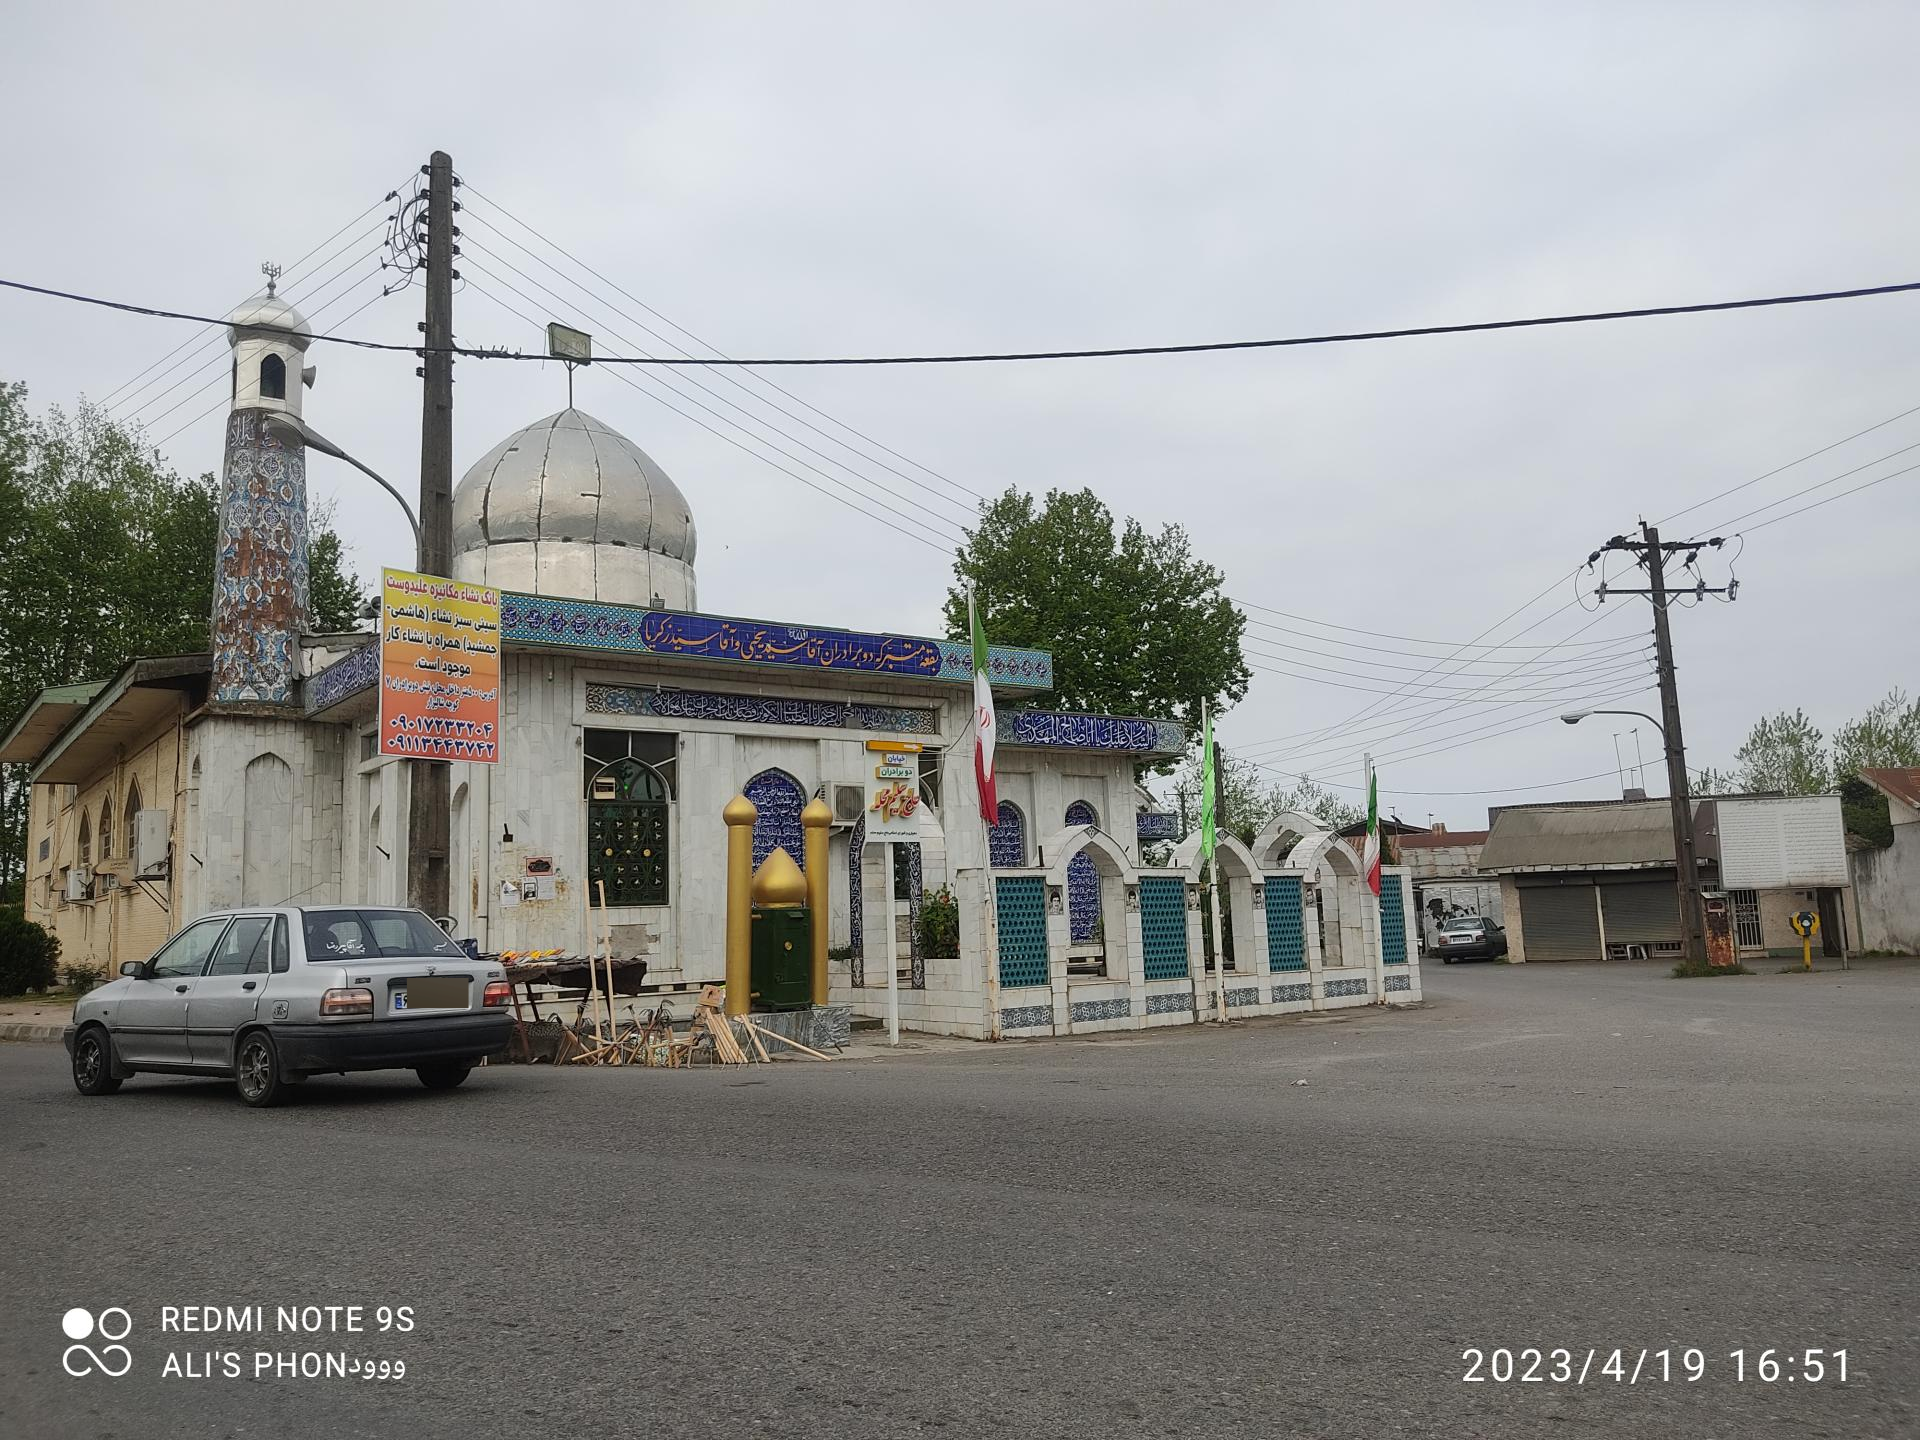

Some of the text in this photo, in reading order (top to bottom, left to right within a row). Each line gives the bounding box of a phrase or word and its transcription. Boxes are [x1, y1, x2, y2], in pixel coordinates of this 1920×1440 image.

[386, 575, 498, 606] بانک نشاء مکانیزه علیدوست
[431, 610, 452, 625] نشاء
[453, 614, 472, 628] سبز
[474, 618, 498, 632] سینی
[386, 625, 498, 659] جمشید) همراه با نشاء کار
[719, 623, 737, 650] آقا
[806, 638, 825, 659] آقا
[820, 641, 863, 666] برادران
[862, 651, 873, 663] دو
[415, 657, 471, 676] موجود است.
[390, 714, 494, 739] ۰۹۰۱۷۲۳۳۲۰۴
[388, 733, 495, 758] ۰۹۱۱۳۴۴۳۷۴۲
[887, 754, 906, 763] خیابان
[881, 767, 904, 777] برادران
